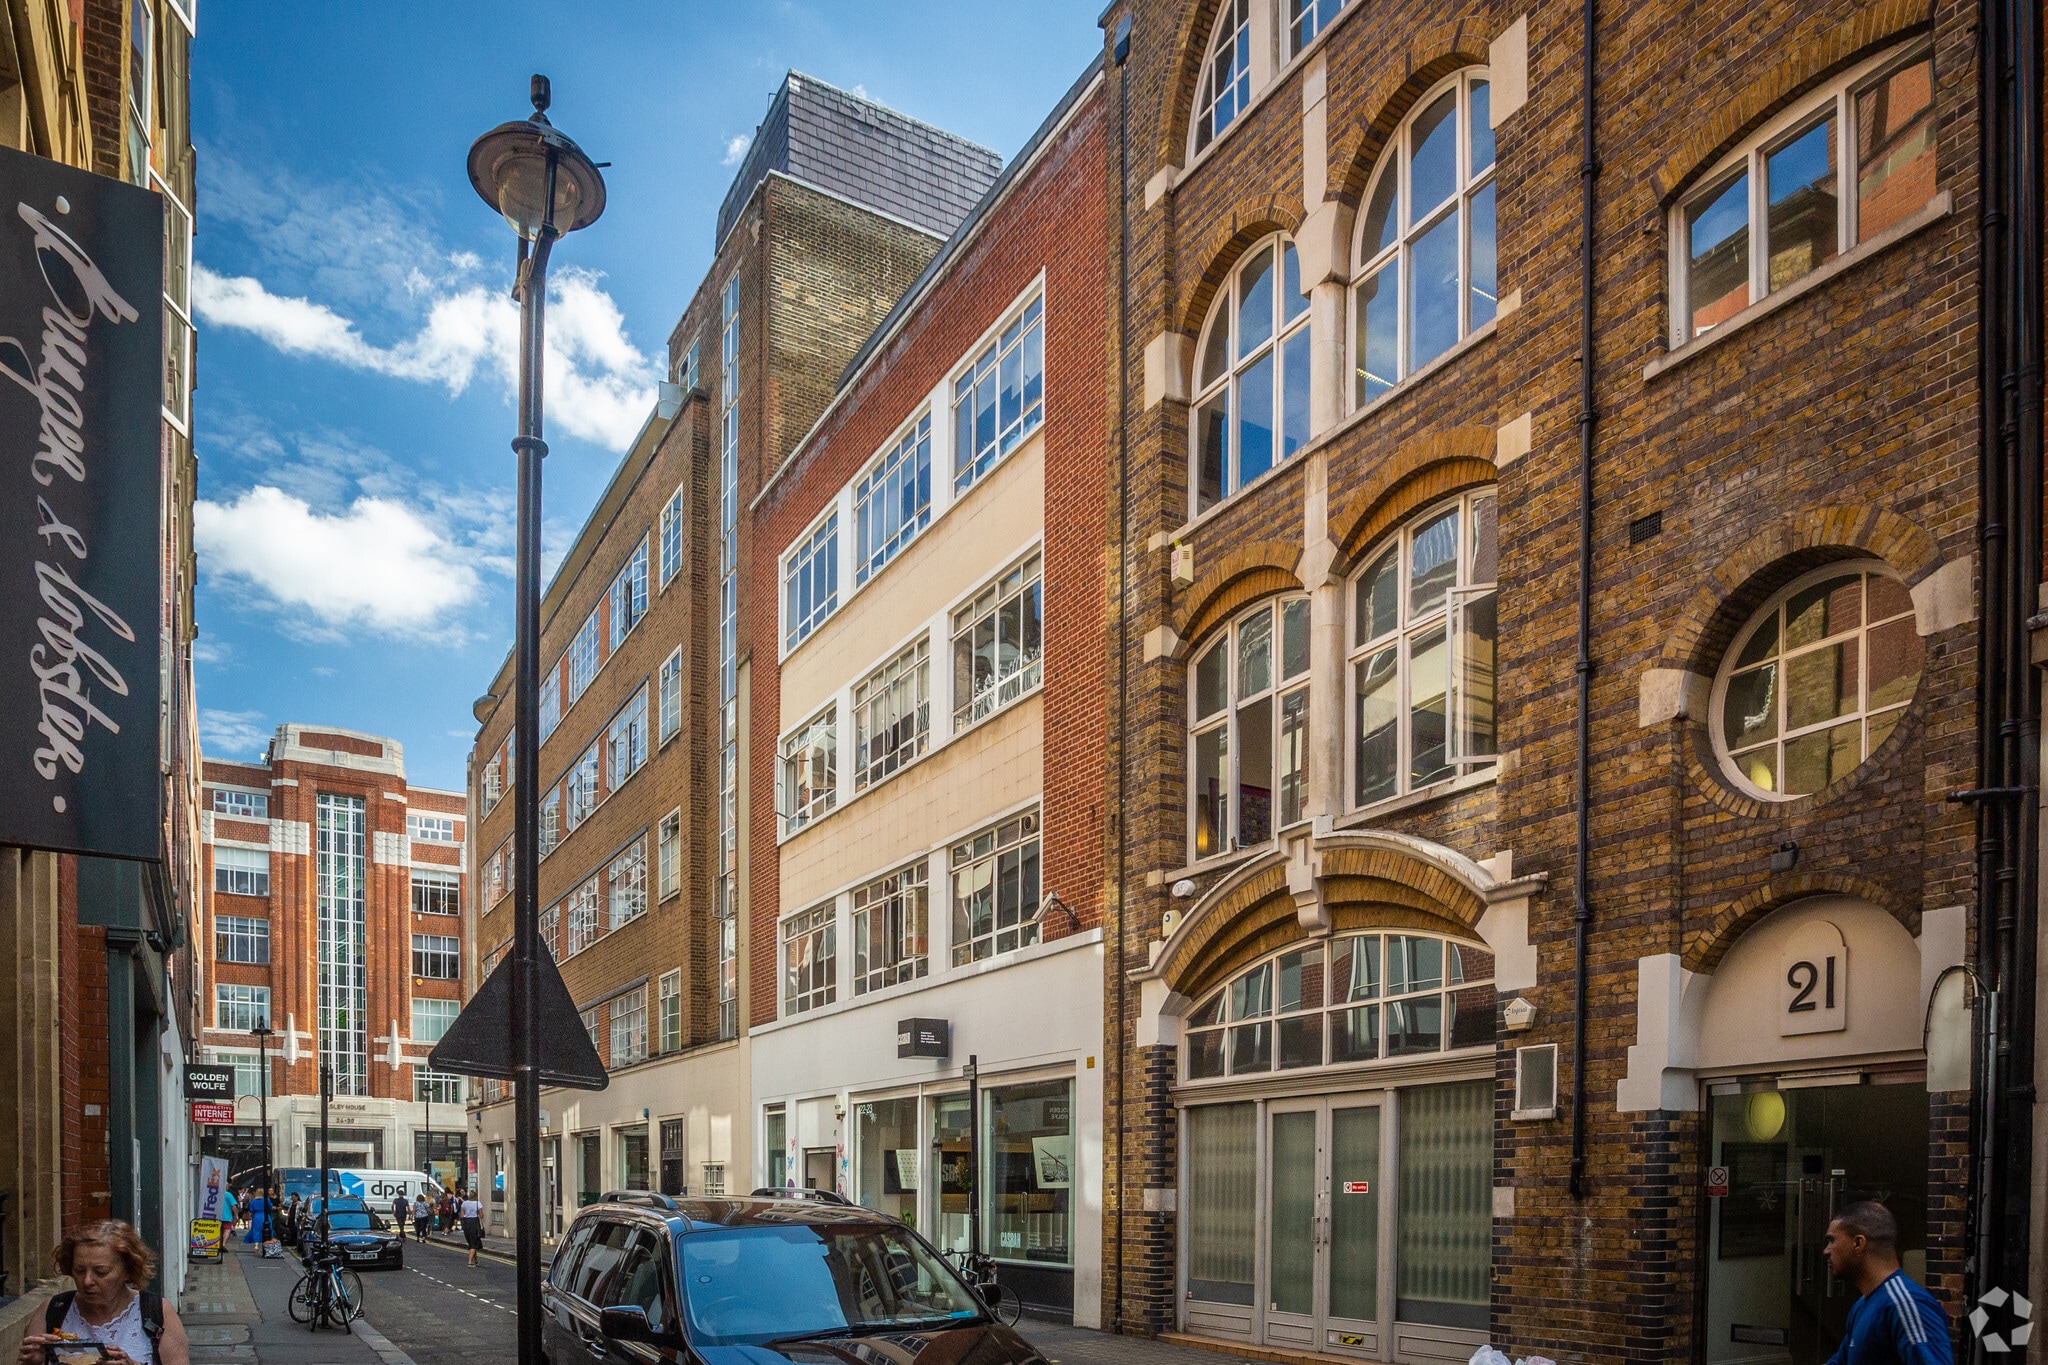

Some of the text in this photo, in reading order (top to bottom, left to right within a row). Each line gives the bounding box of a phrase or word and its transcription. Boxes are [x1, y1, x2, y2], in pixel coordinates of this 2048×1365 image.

[37, 495, 87, 559] &
[1786, 955, 1835, 1013] 21
[189, 1072, 229, 1082] GOLDEN
[192, 1081, 226, 1090] WOLFE
[194, 1109, 233, 1119] INTERNET
[203, 1167, 221, 1212] FedEx
[371, 1181, 408, 1200] dpd
